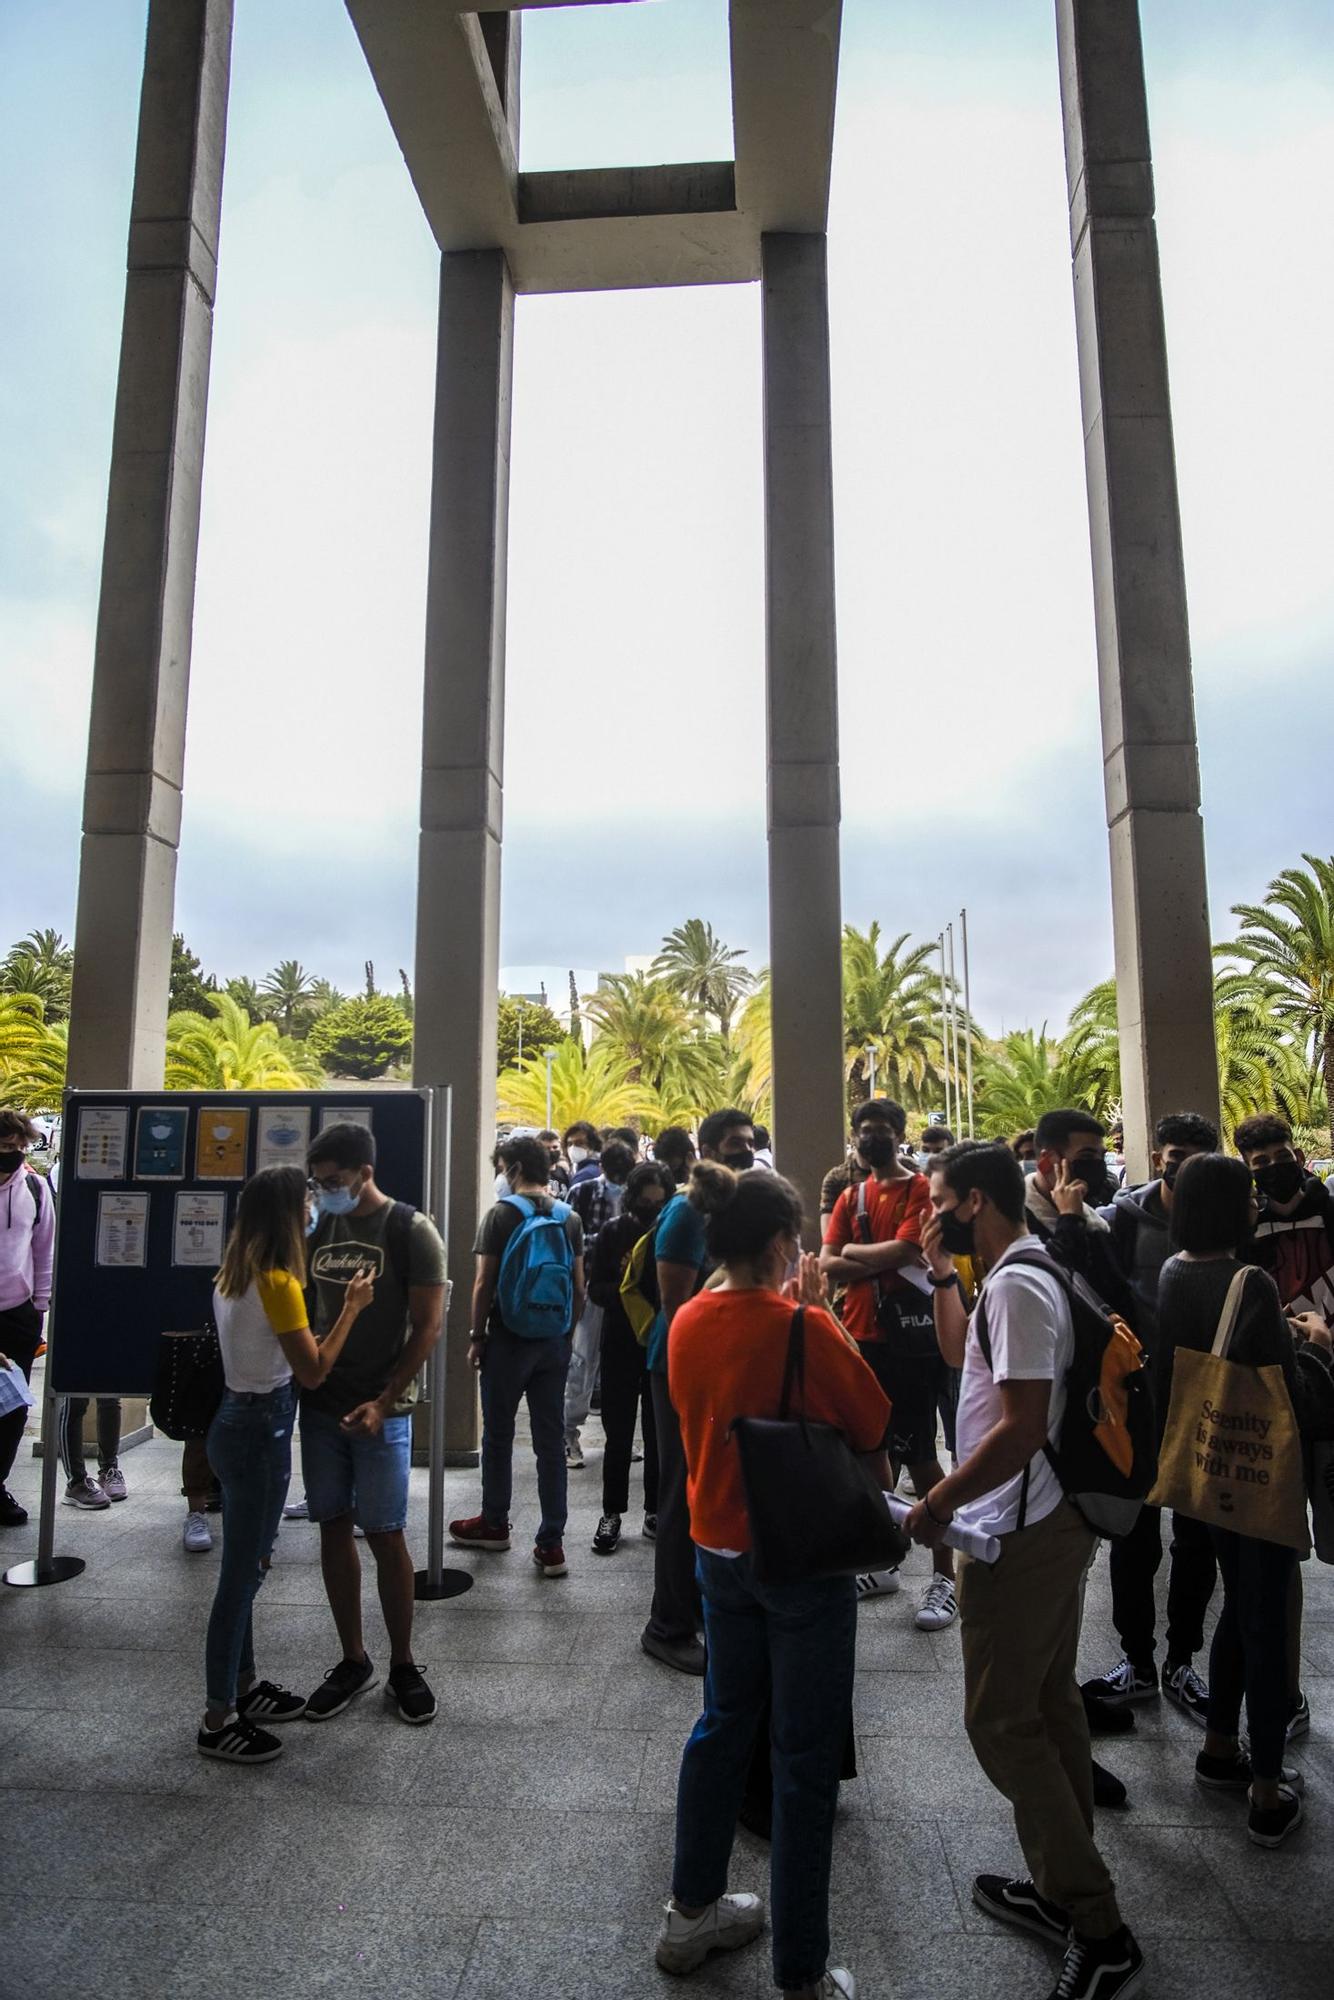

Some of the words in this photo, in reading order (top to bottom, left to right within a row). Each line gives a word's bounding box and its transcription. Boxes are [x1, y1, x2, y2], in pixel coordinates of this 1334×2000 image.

[900, 1314, 933, 1328] FILA
[1196, 1422, 1208, 1445] is
[1195, 1451, 1229, 1478] with
[1236, 1465, 1269, 1485] me
